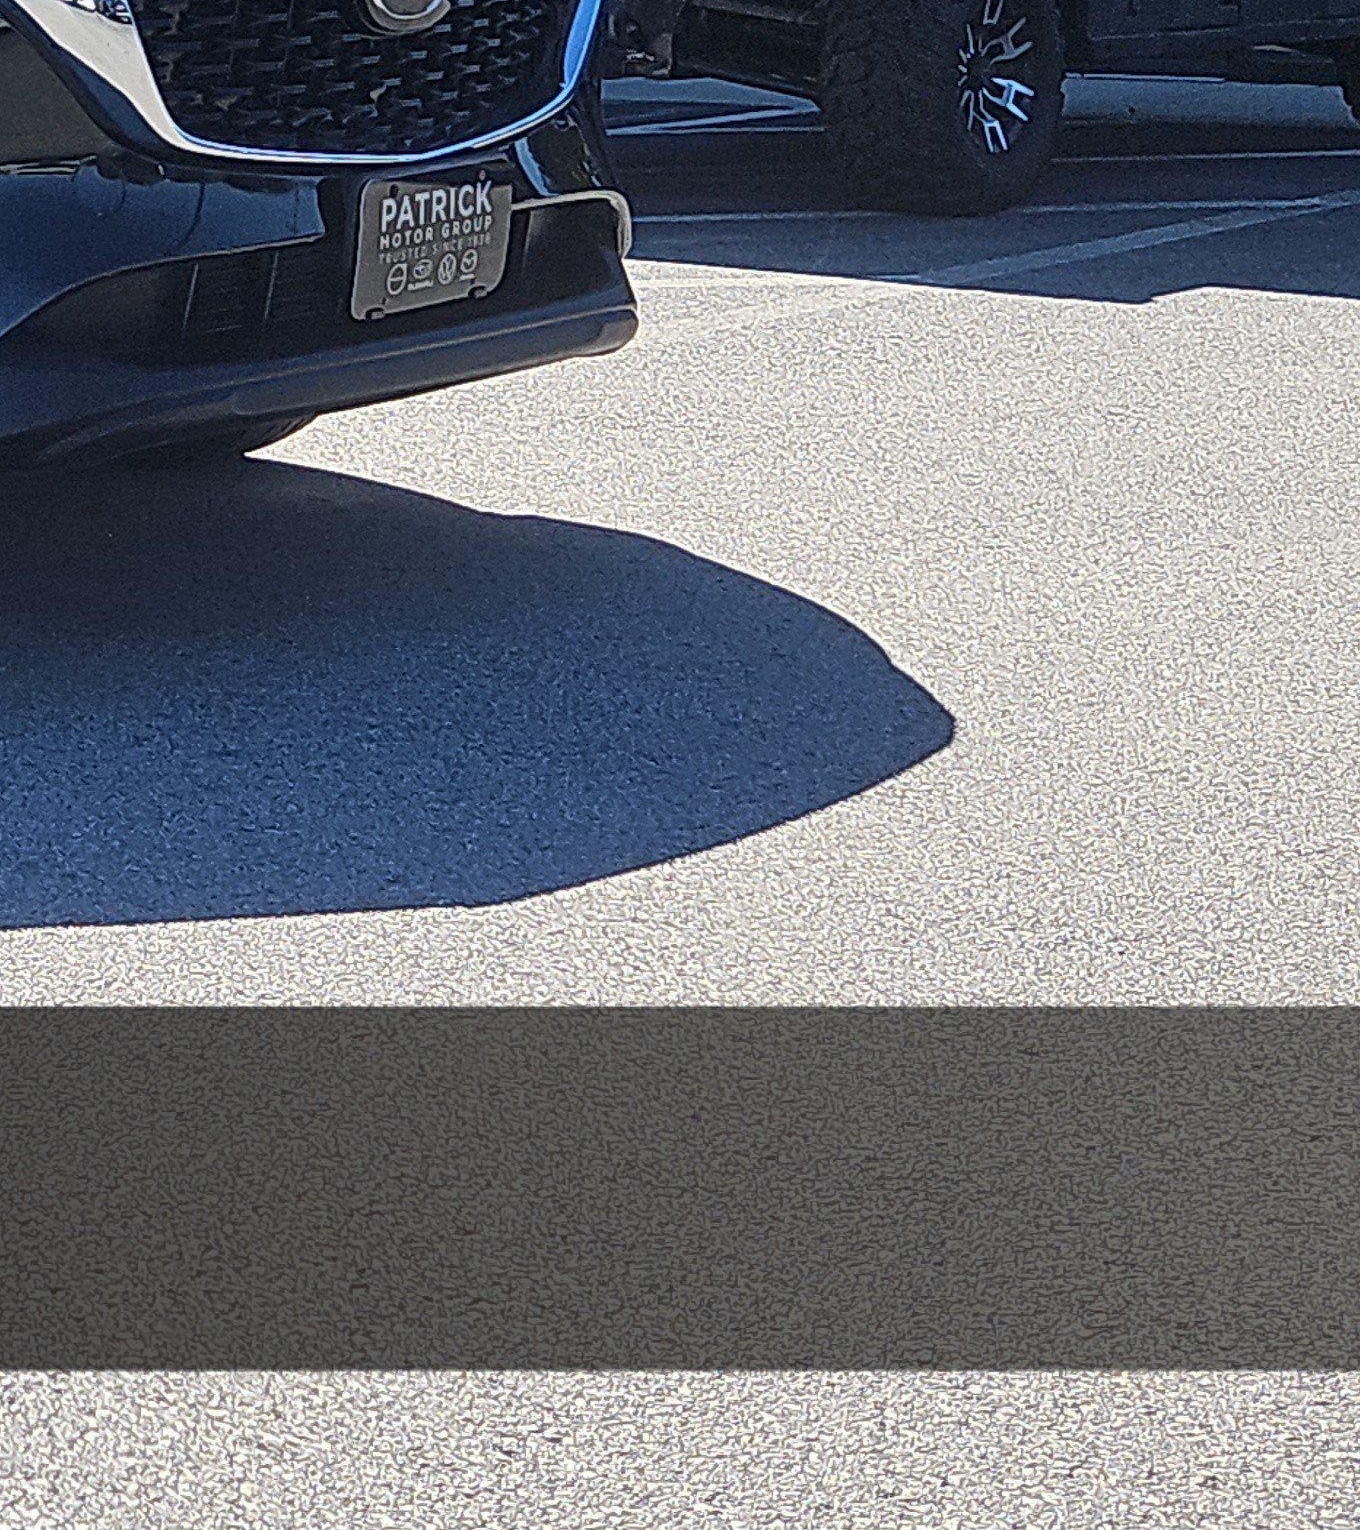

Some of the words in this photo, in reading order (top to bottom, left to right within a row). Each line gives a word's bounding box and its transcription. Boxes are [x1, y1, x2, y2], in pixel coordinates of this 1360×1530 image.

[381, 181, 492, 233] PATRICK
[380, 227, 434, 250] MOTOR
[441, 215, 492, 239] GROUP
[380, 245, 427, 264] TRUSTED
